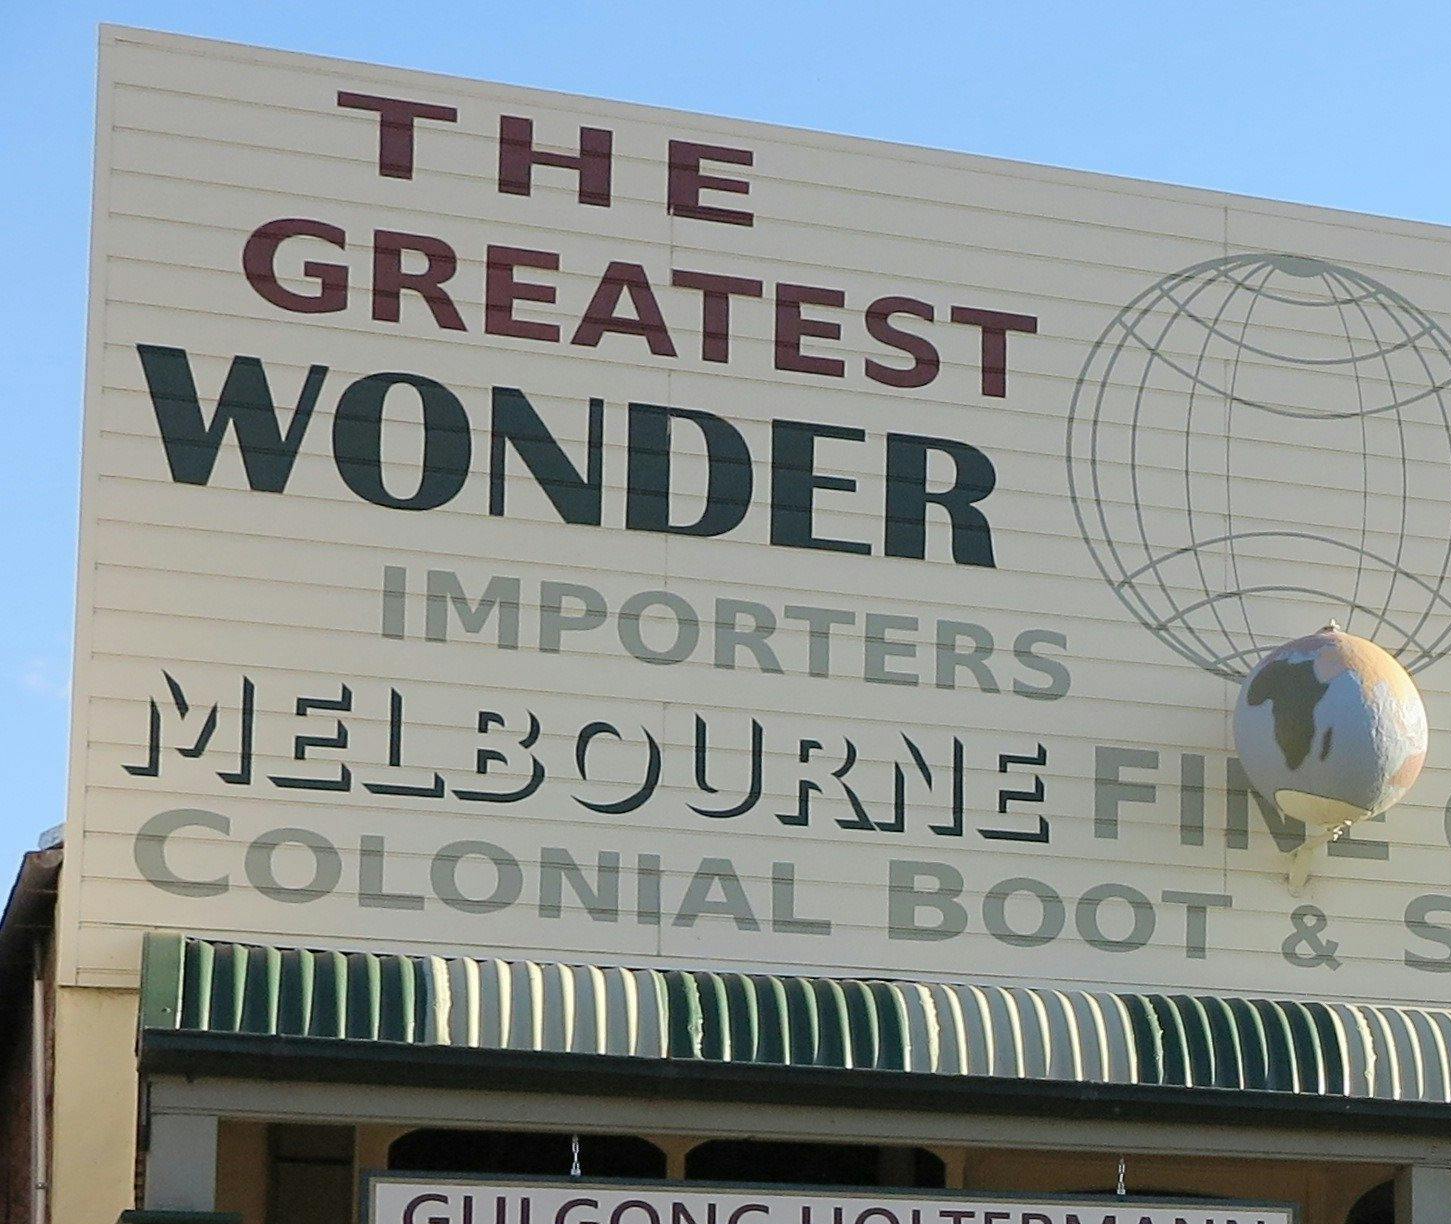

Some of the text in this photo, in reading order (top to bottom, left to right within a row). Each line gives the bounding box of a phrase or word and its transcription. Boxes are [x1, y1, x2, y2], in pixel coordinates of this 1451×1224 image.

[336, 90, 754, 228] THE
[242, 217, 1037, 398] GREATEST
[136, 343, 997, 568] WONDER
[381, 565, 1072, 701] IMPORTERS
[122, 669, 1050, 843] MELBOURNE
[133, 807, 832, 938] COLONIAL
[887, 859, 1233, 960] BOOT
[1282, 904, 1342, 972] &
